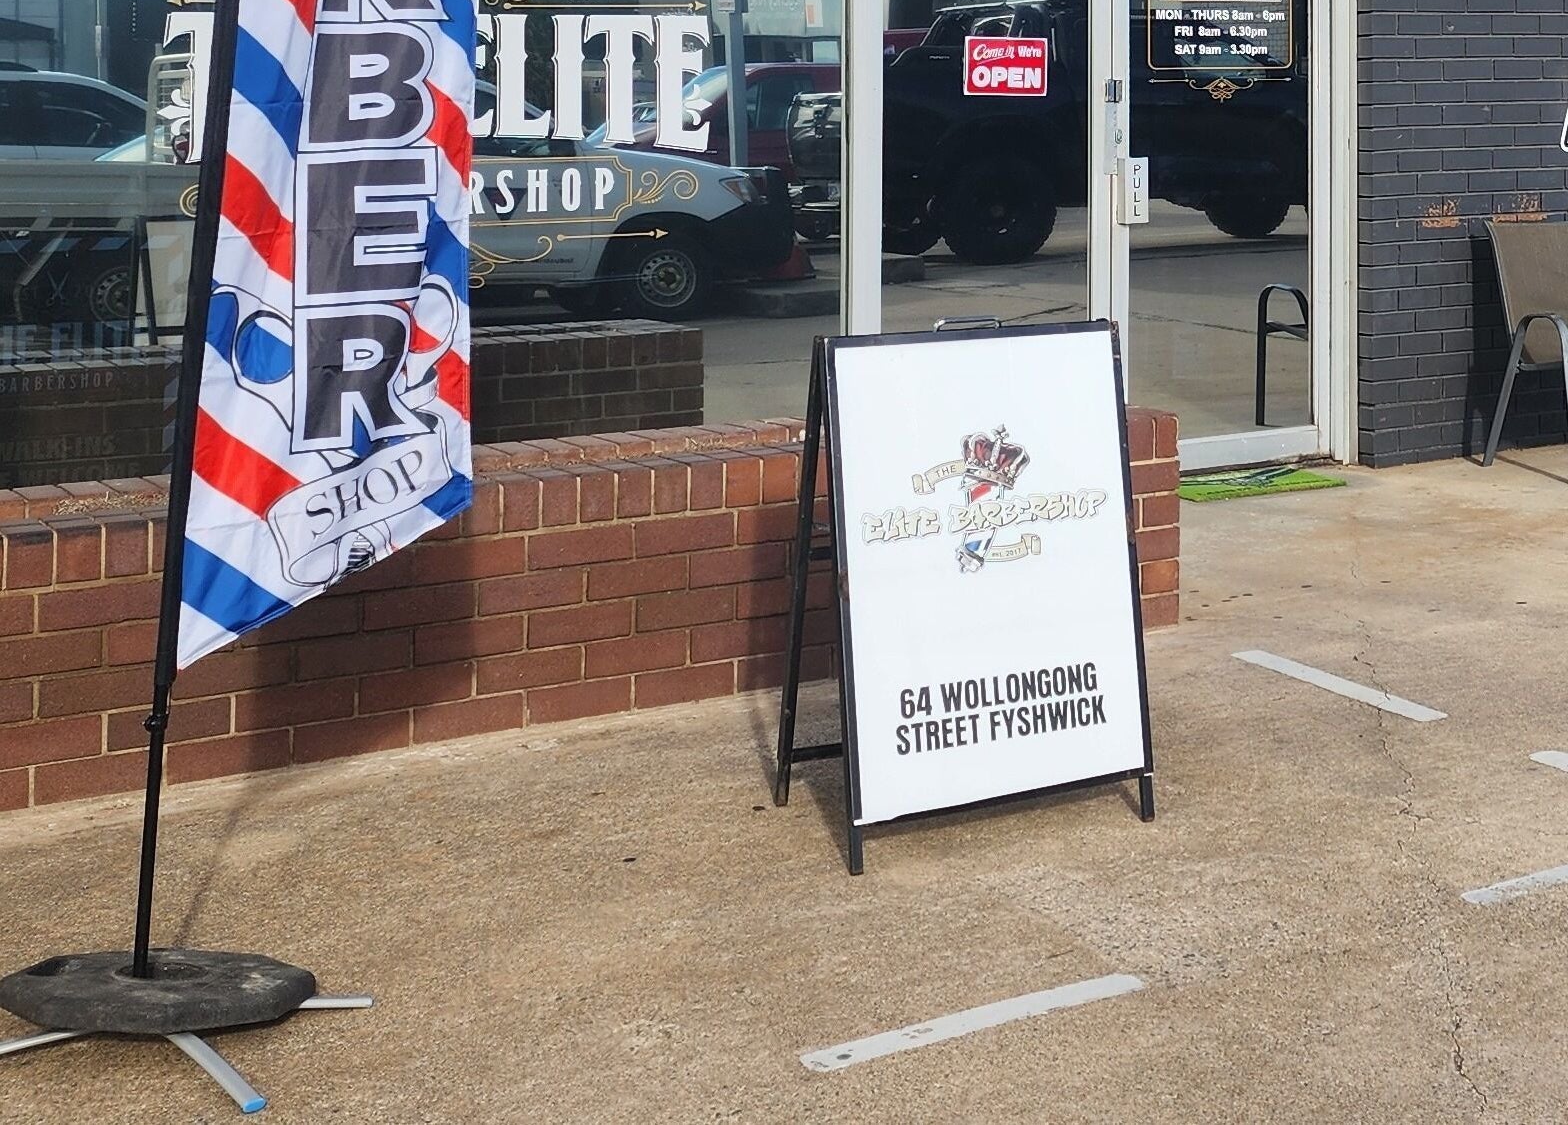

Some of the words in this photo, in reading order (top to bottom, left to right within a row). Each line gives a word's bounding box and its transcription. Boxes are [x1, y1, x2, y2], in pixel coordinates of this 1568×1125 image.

[1155, 9, 1183, 21] MON
[1191, 9, 1230, 21] THURS
[1231, 10, 1254, 21] 8am
[1174, 26, 1193, 37] FRI
[1198, 26, 1221, 37] 8am
[1229, 26, 1268, 39] 6.30pm
[972, 43, 1005, 61] Come
[1174, 44, 1197, 55] SAT
[1198, 44, 1222, 55] 9am
[1230, 44, 1268, 57] 3.30pm
[971, 65, 1042, 89] OPEN
[1133, 164, 1142, 217] PULL
[935, 465, 957, 477] THE
[304, 449, 426, 541] SHOP
[949, 488, 1108, 534] BARBERSHOP
[900, 686, 933, 719] 64
[940, 662, 1098, 714] WOLLONGONG
[896, 714, 980, 756] STREET
[989, 694, 1107, 742] FYSHWICK
